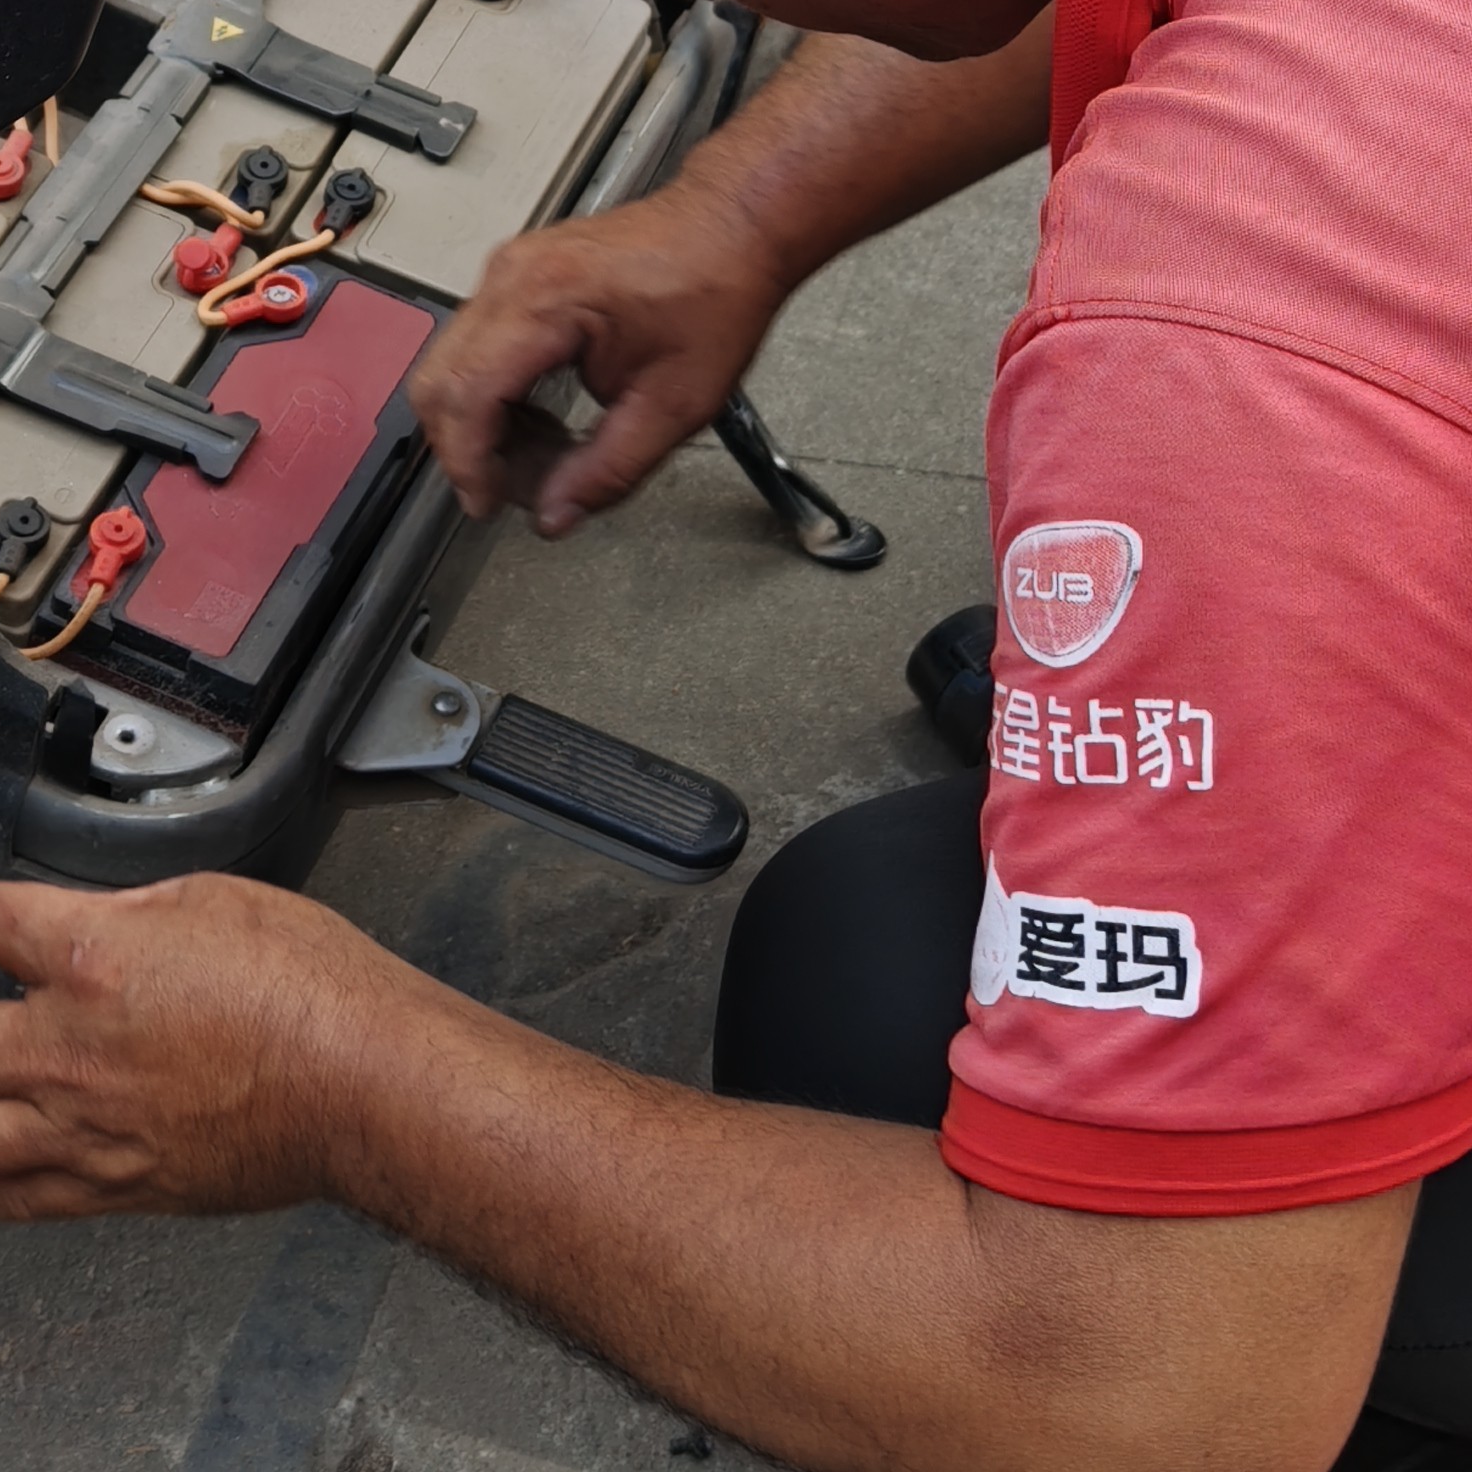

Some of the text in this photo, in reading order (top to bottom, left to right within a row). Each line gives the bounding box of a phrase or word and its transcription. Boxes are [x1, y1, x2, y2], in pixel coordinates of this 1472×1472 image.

[988, 683, 1214, 792] 星钻豹
[1017, 905, 1189, 1001] 爱玛
